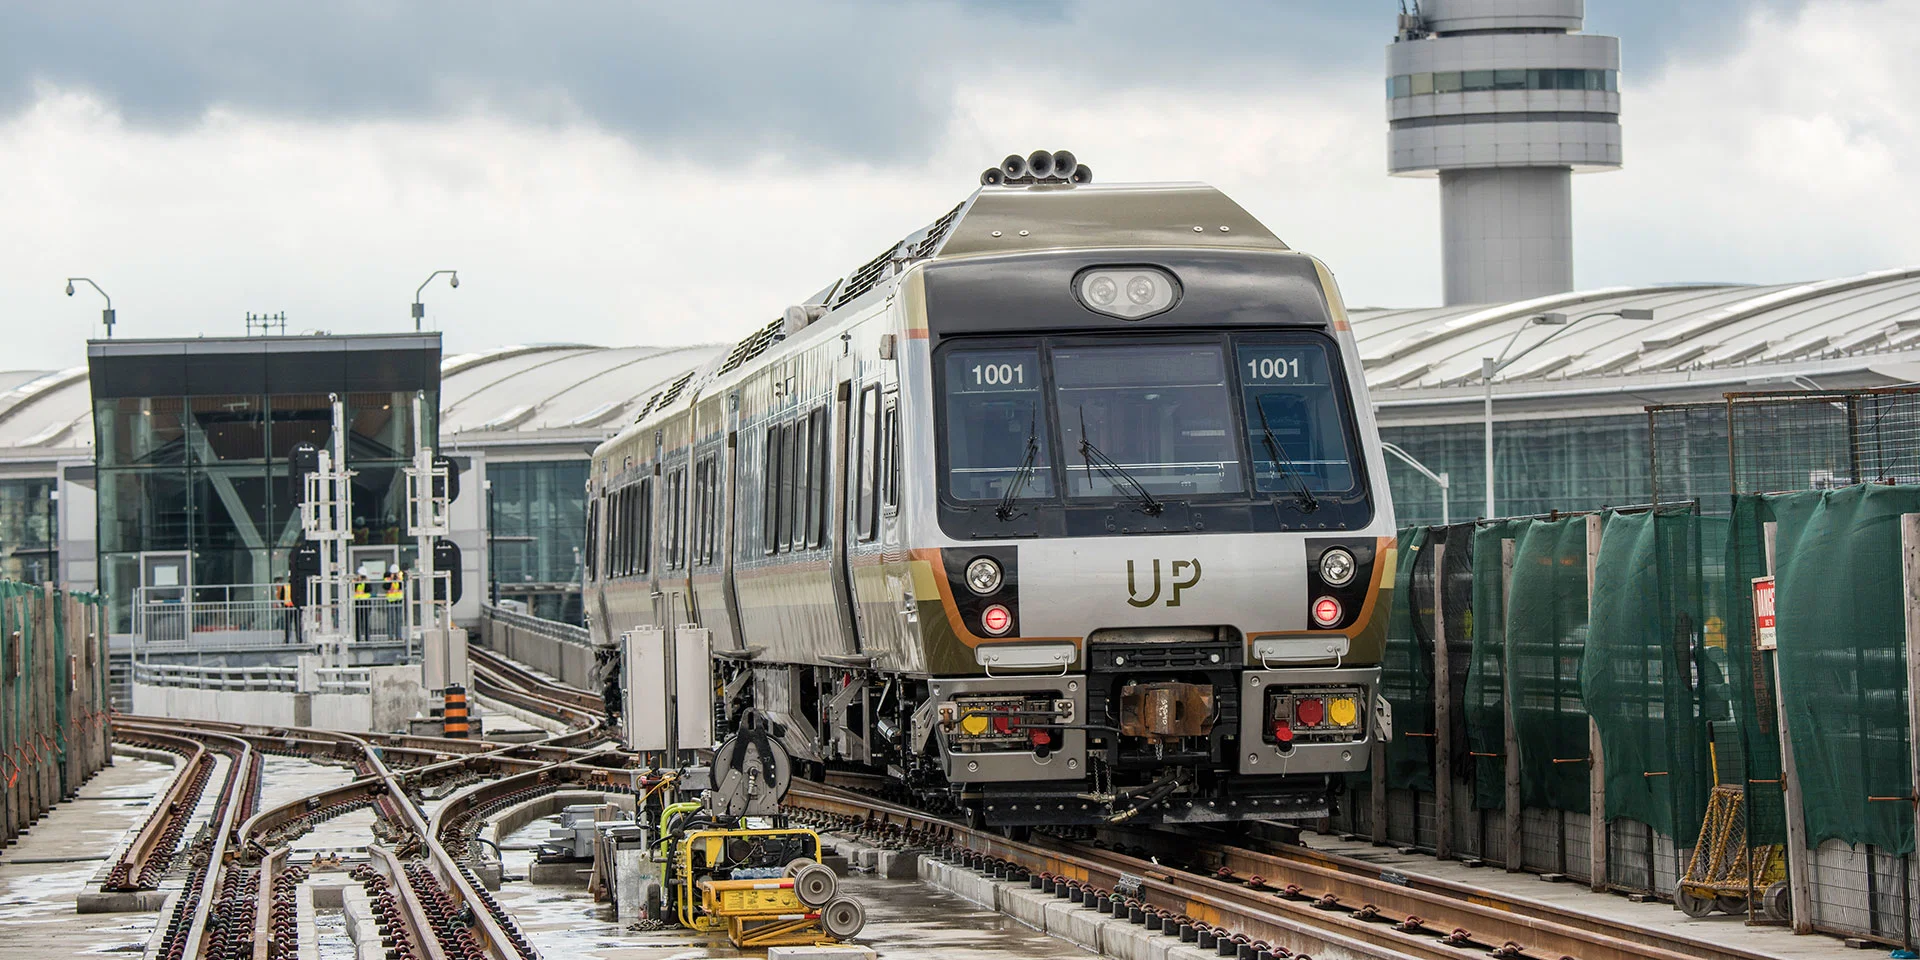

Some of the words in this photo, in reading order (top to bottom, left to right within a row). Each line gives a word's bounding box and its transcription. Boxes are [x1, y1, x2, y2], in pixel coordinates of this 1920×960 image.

[972, 364, 1023, 385] 1001
[1247, 358, 1299, 379] 1001
[1127, 558, 1202, 608] UP
[1756, 588, 1775, 617] DANGE
